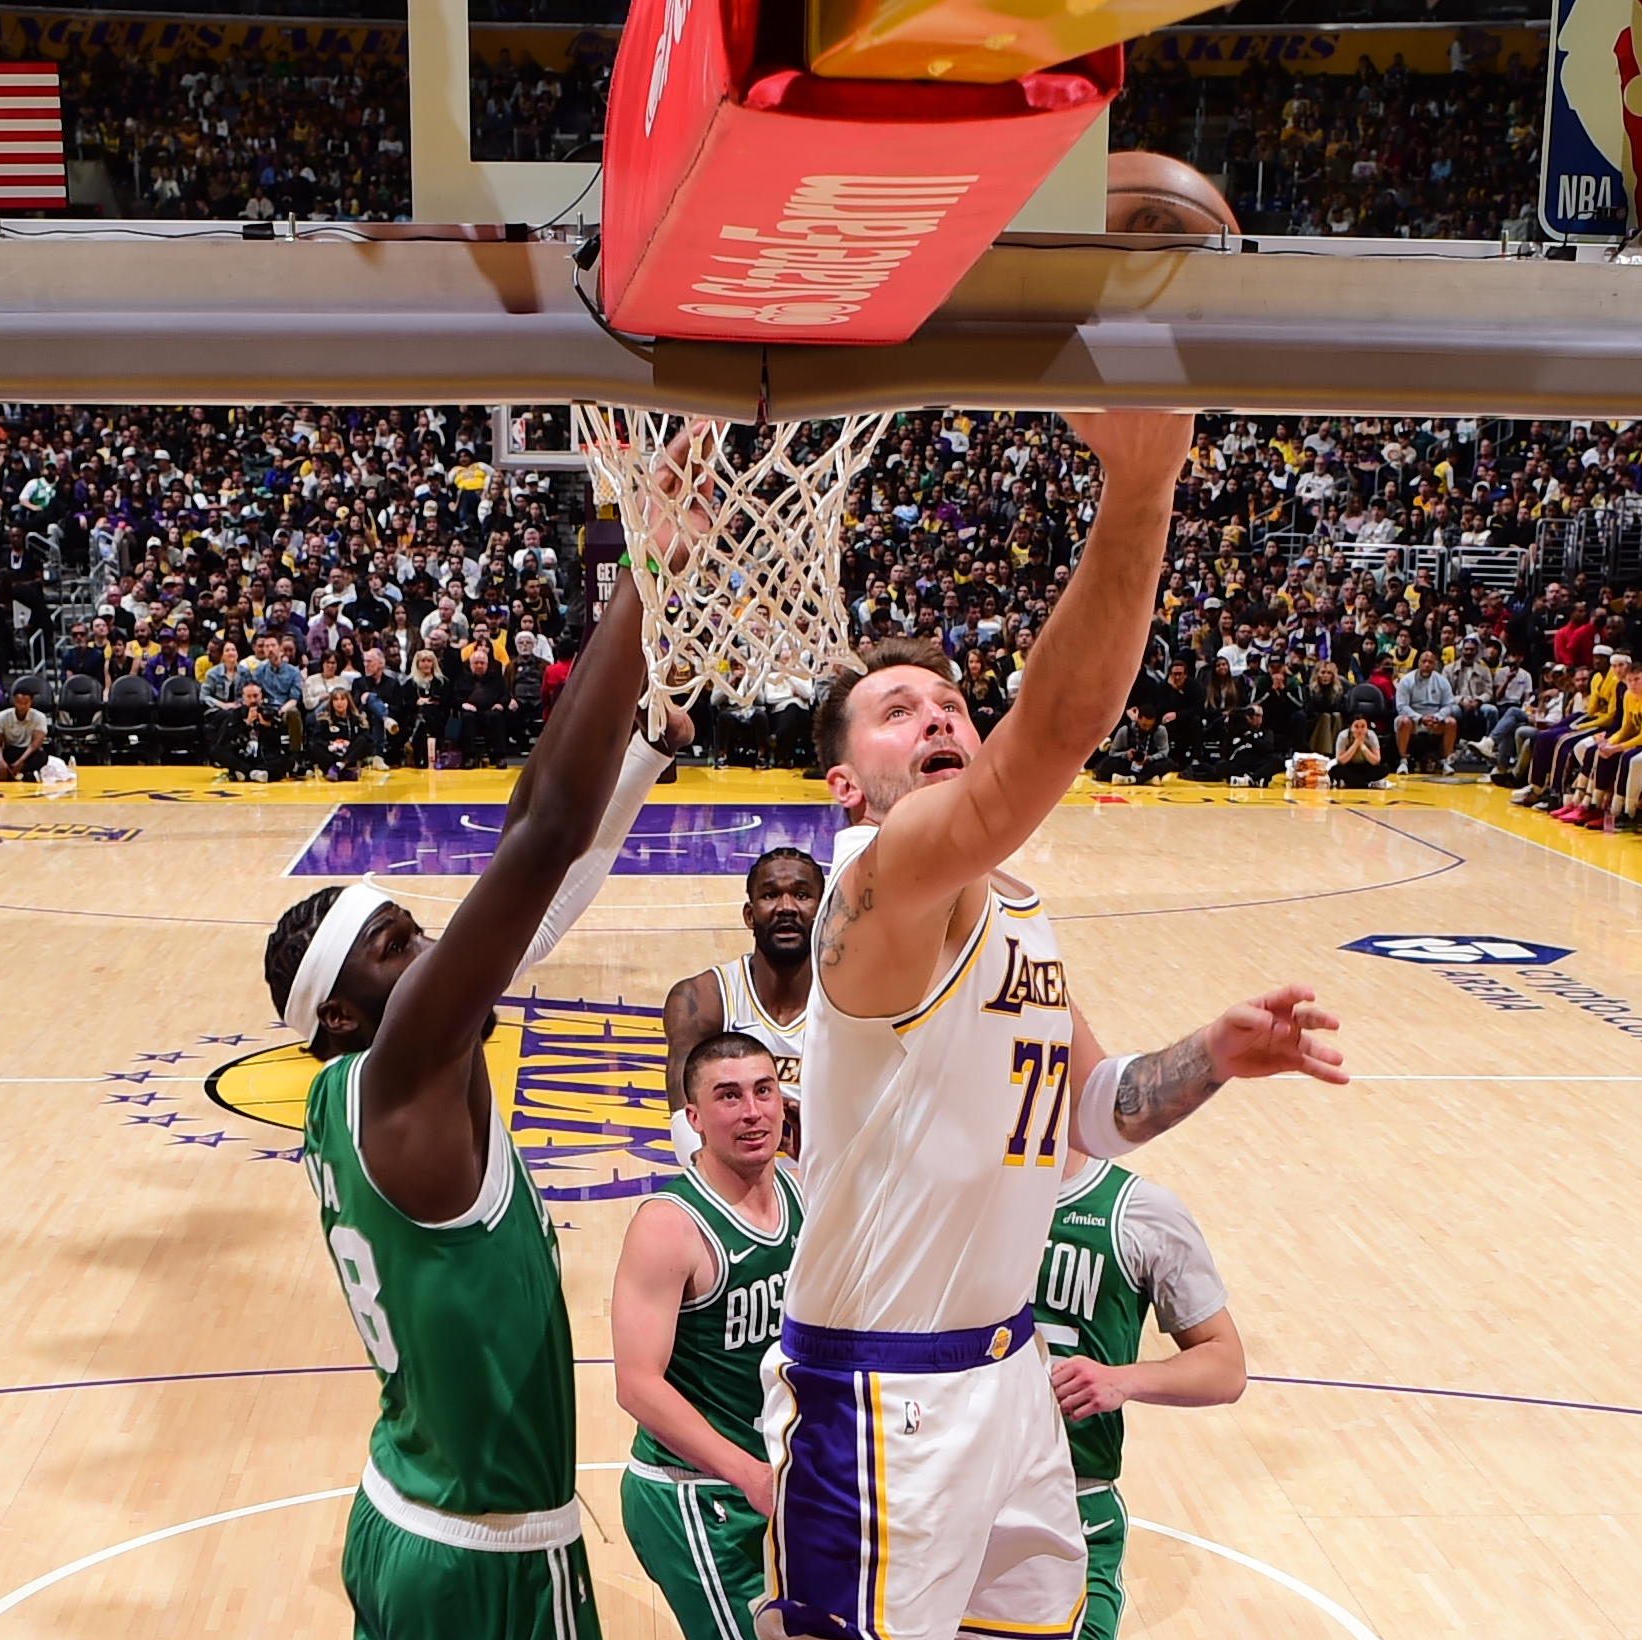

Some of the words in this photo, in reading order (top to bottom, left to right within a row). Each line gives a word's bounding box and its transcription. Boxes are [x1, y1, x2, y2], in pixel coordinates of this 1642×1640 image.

[1557, 174, 1613, 220] NBA
[596, 563, 618, 582] GET
[597, 583, 615, 601] TH
[1002, 1036, 1072, 1168] 77
[1062, 1211, 1107, 1227] Amica
[723, 1269, 789, 1351] BOS
